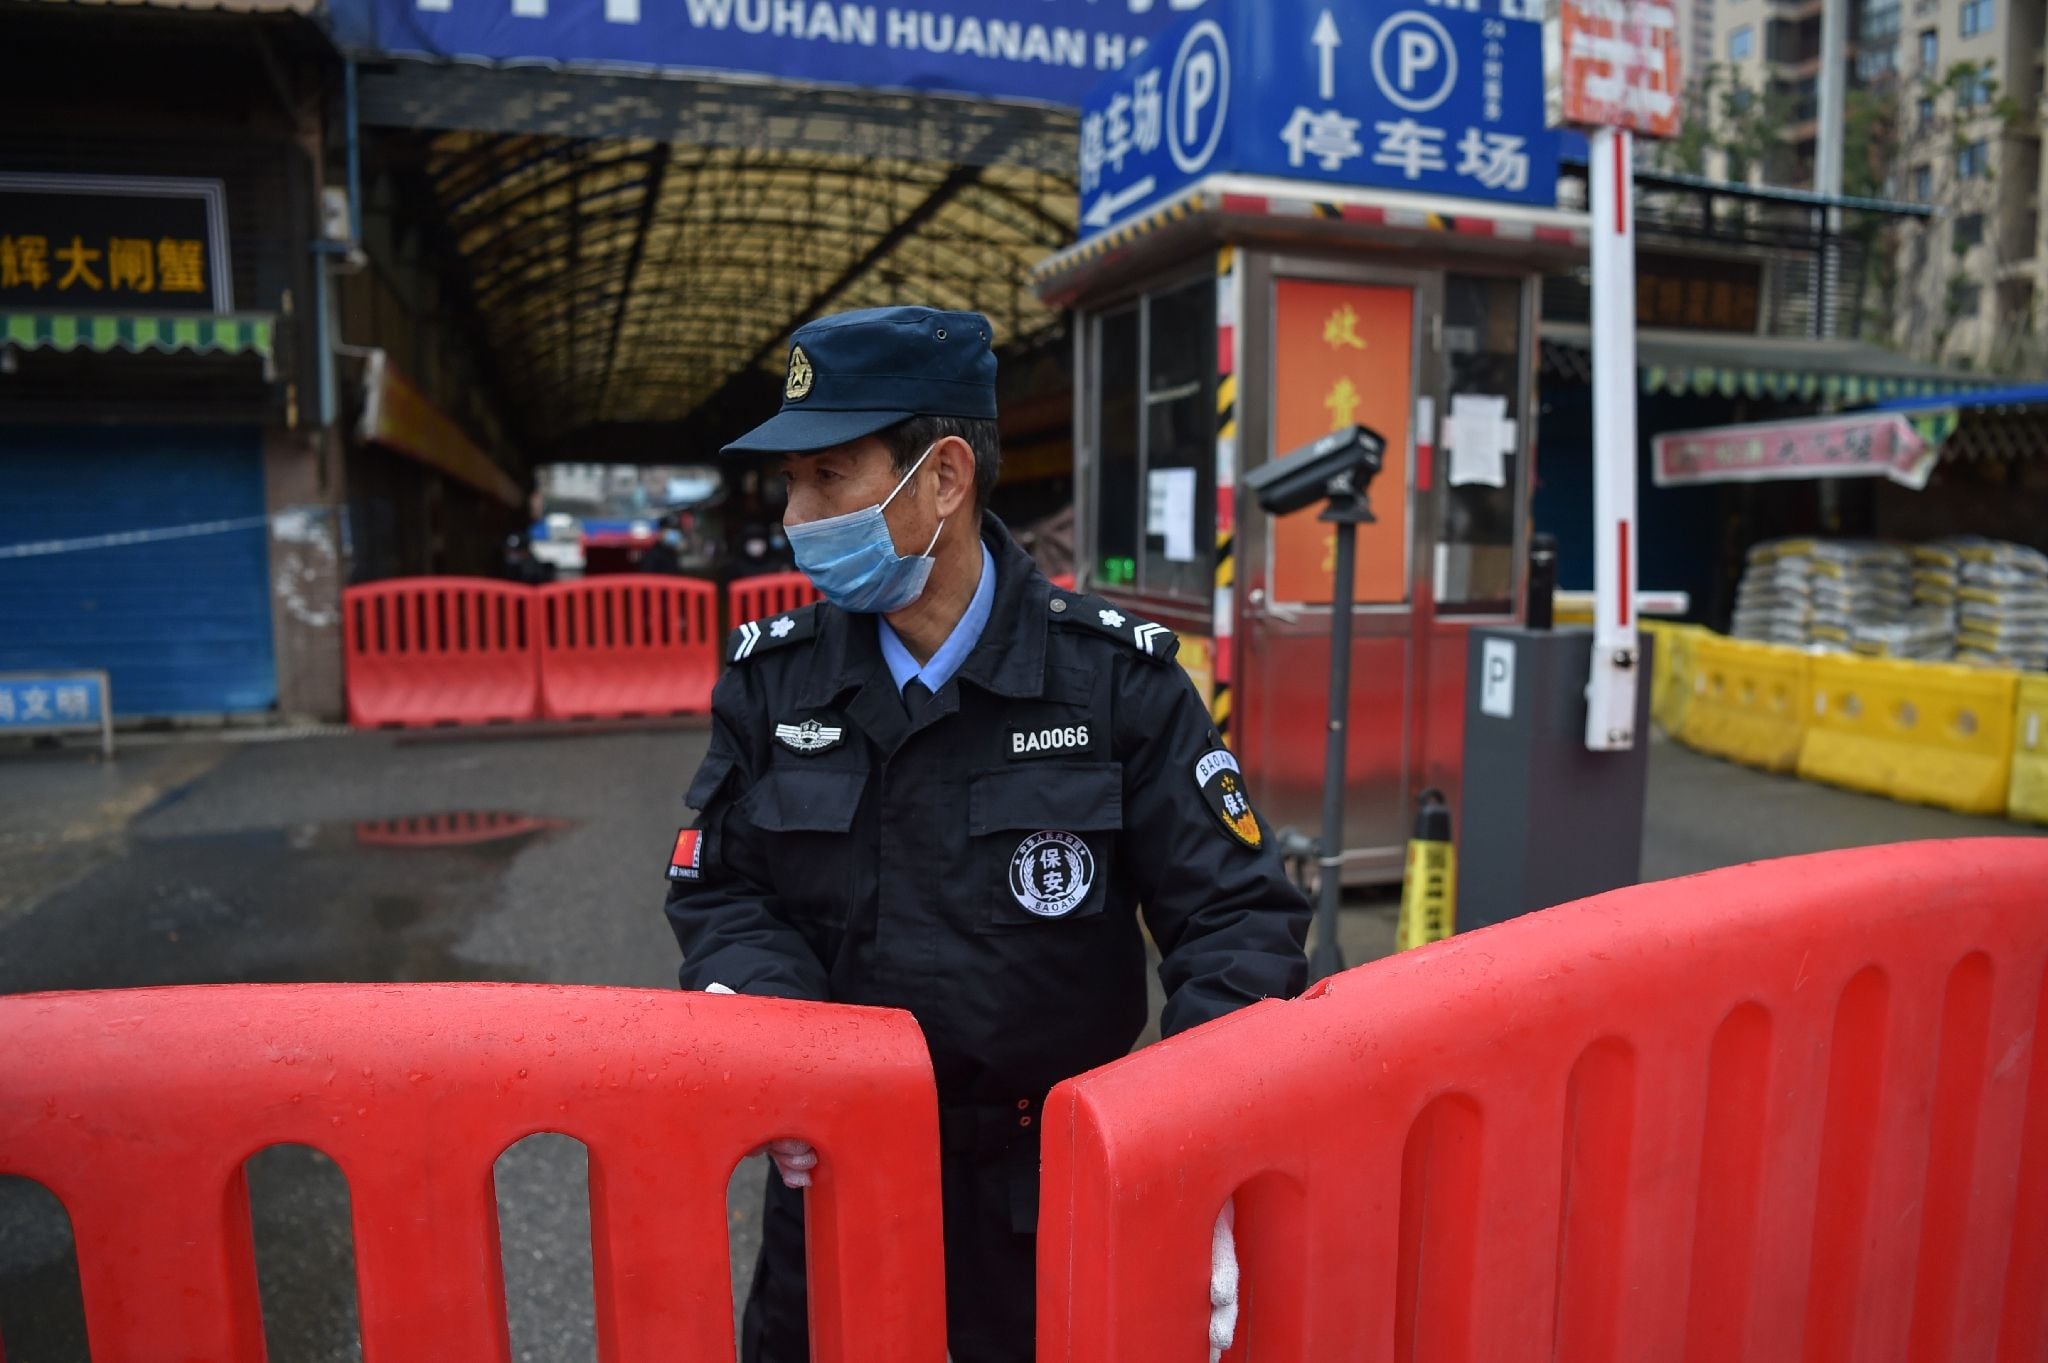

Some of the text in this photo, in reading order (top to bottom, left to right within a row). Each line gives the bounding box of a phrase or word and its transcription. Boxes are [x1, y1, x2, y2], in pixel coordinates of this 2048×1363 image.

[685, 0, 877, 47] WUHAN
[886, 4, 1086, 70] HUANAN
[1399, 29, 1438, 92] P
[1278, 105, 1530, 193] 停车场
[1, 233, 207, 294] 辉大闸蟹
[1012, 725, 1089, 753] BA0066
[1040, 848, 1064, 893] 保安
[1034, 894, 1076, 913] BAOAN
